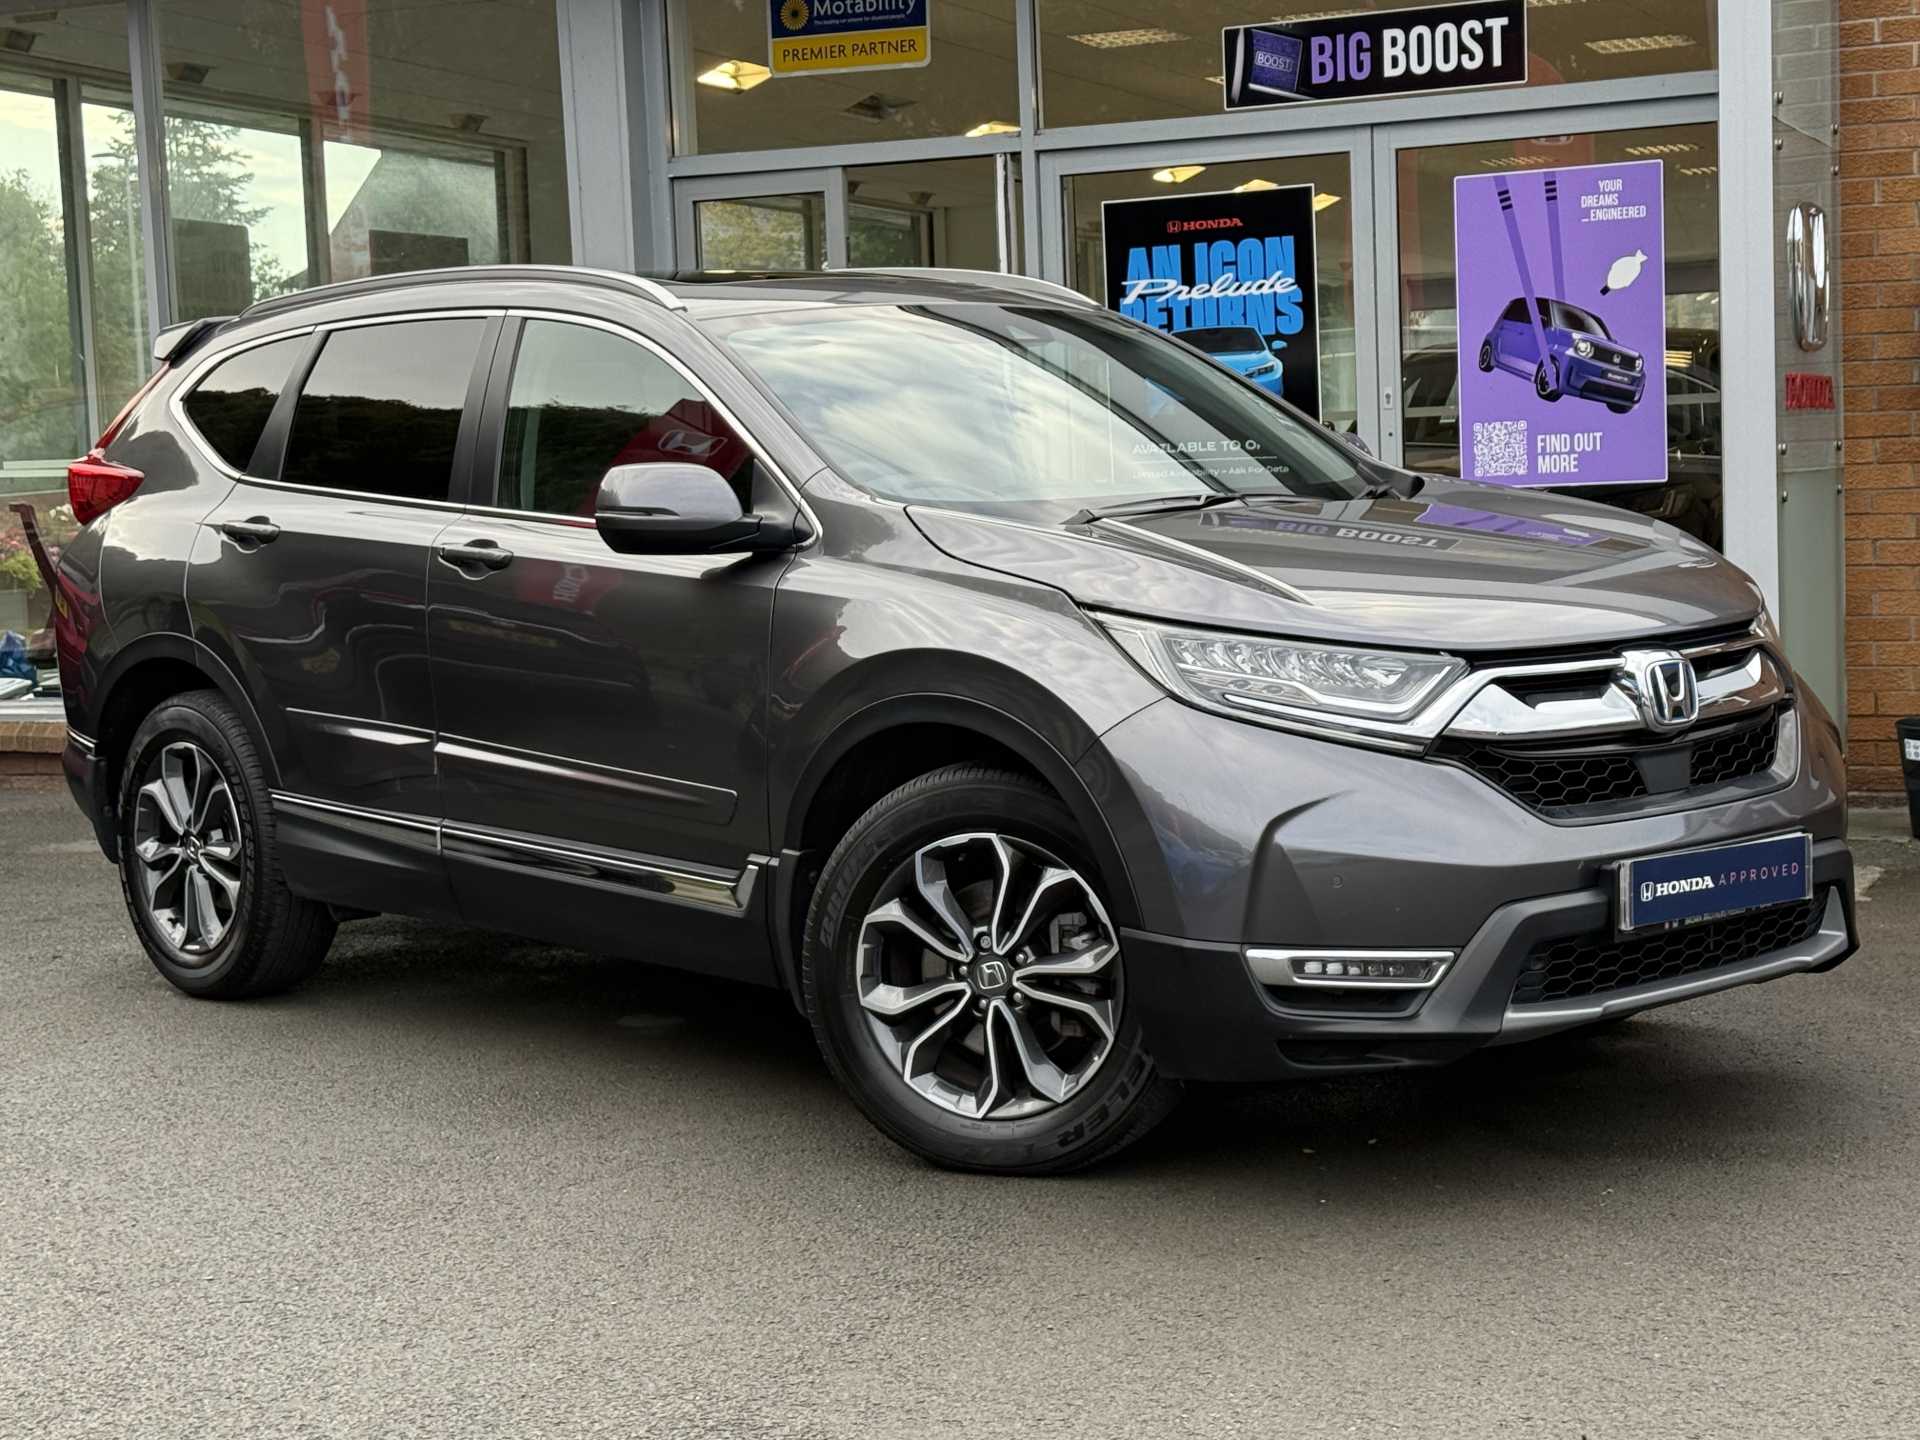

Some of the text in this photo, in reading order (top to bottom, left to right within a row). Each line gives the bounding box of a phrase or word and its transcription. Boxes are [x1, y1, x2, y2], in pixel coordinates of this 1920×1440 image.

[782, 39, 918, 62] PREMIER PARTNER
[1257, 51, 1293, 70] BOOST
[1310, 17, 1509, 85] BIG BOOST
[1598, 179, 1623, 192] YOUR
[1581, 193, 1619, 208] DREAMS
[1183, 218, 1244, 231] HONDA
[1126, 236, 1296, 295] AN ICON
[1121, 270, 1299, 305] Prelude
[1120, 288, 1304, 335] RETURNS
[1133, 441, 1217, 454] AVAILABLE
[1222, 440, 1241, 451] TO
[1537, 432, 1603, 453] FIND OUT
[1537, 454, 1579, 474] MORE
[1656, 862, 1800, 897] HONDA APPROVED
